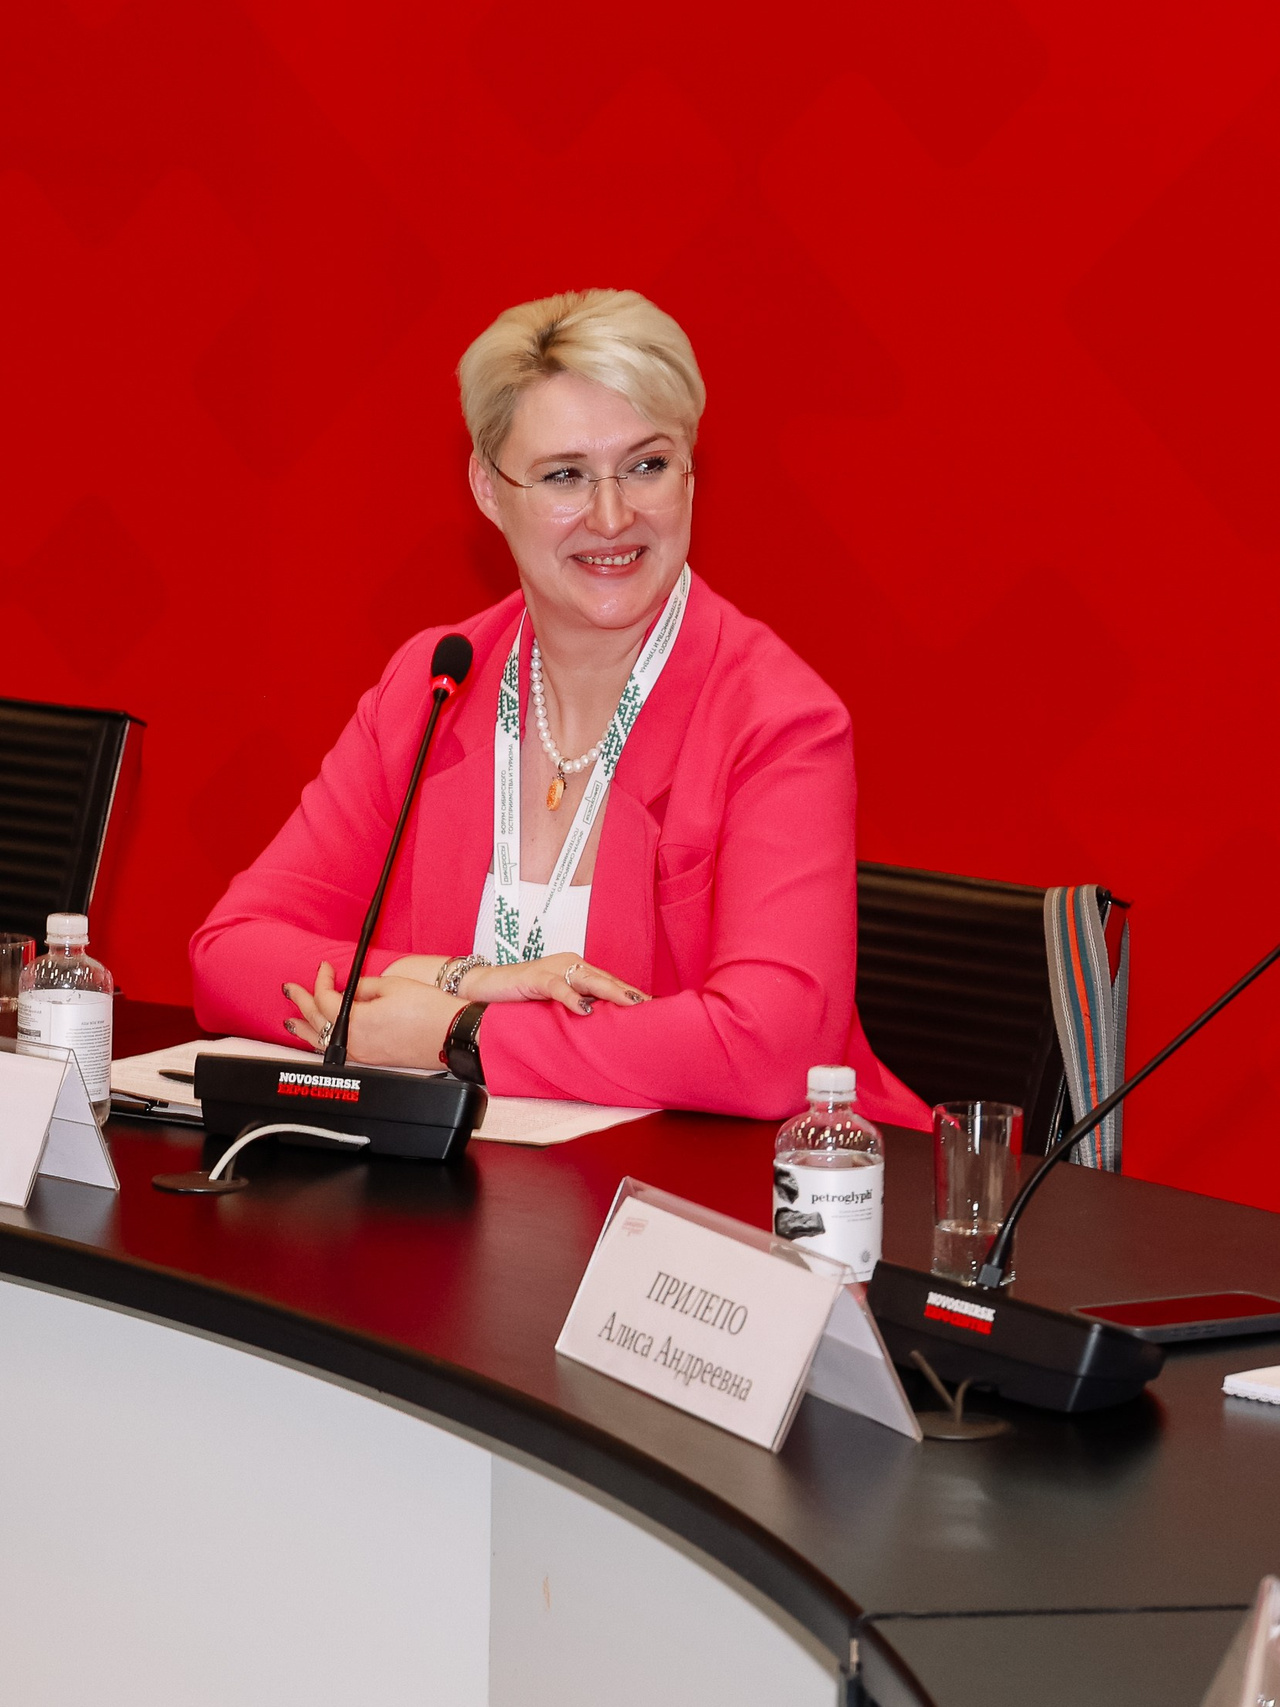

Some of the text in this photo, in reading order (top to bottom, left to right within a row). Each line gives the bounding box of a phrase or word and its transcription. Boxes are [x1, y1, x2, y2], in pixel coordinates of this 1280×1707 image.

[279, 1072, 361, 1090] NOVOSIBIRSK
[277, 1083, 359, 1102] EXPO CENTRE
[811, 1189, 872, 1205] petroglyph
[646, 1271, 748, 1335] ПРИЛЕПО
[598, 1311, 753, 1401] Алиса Андреевна
